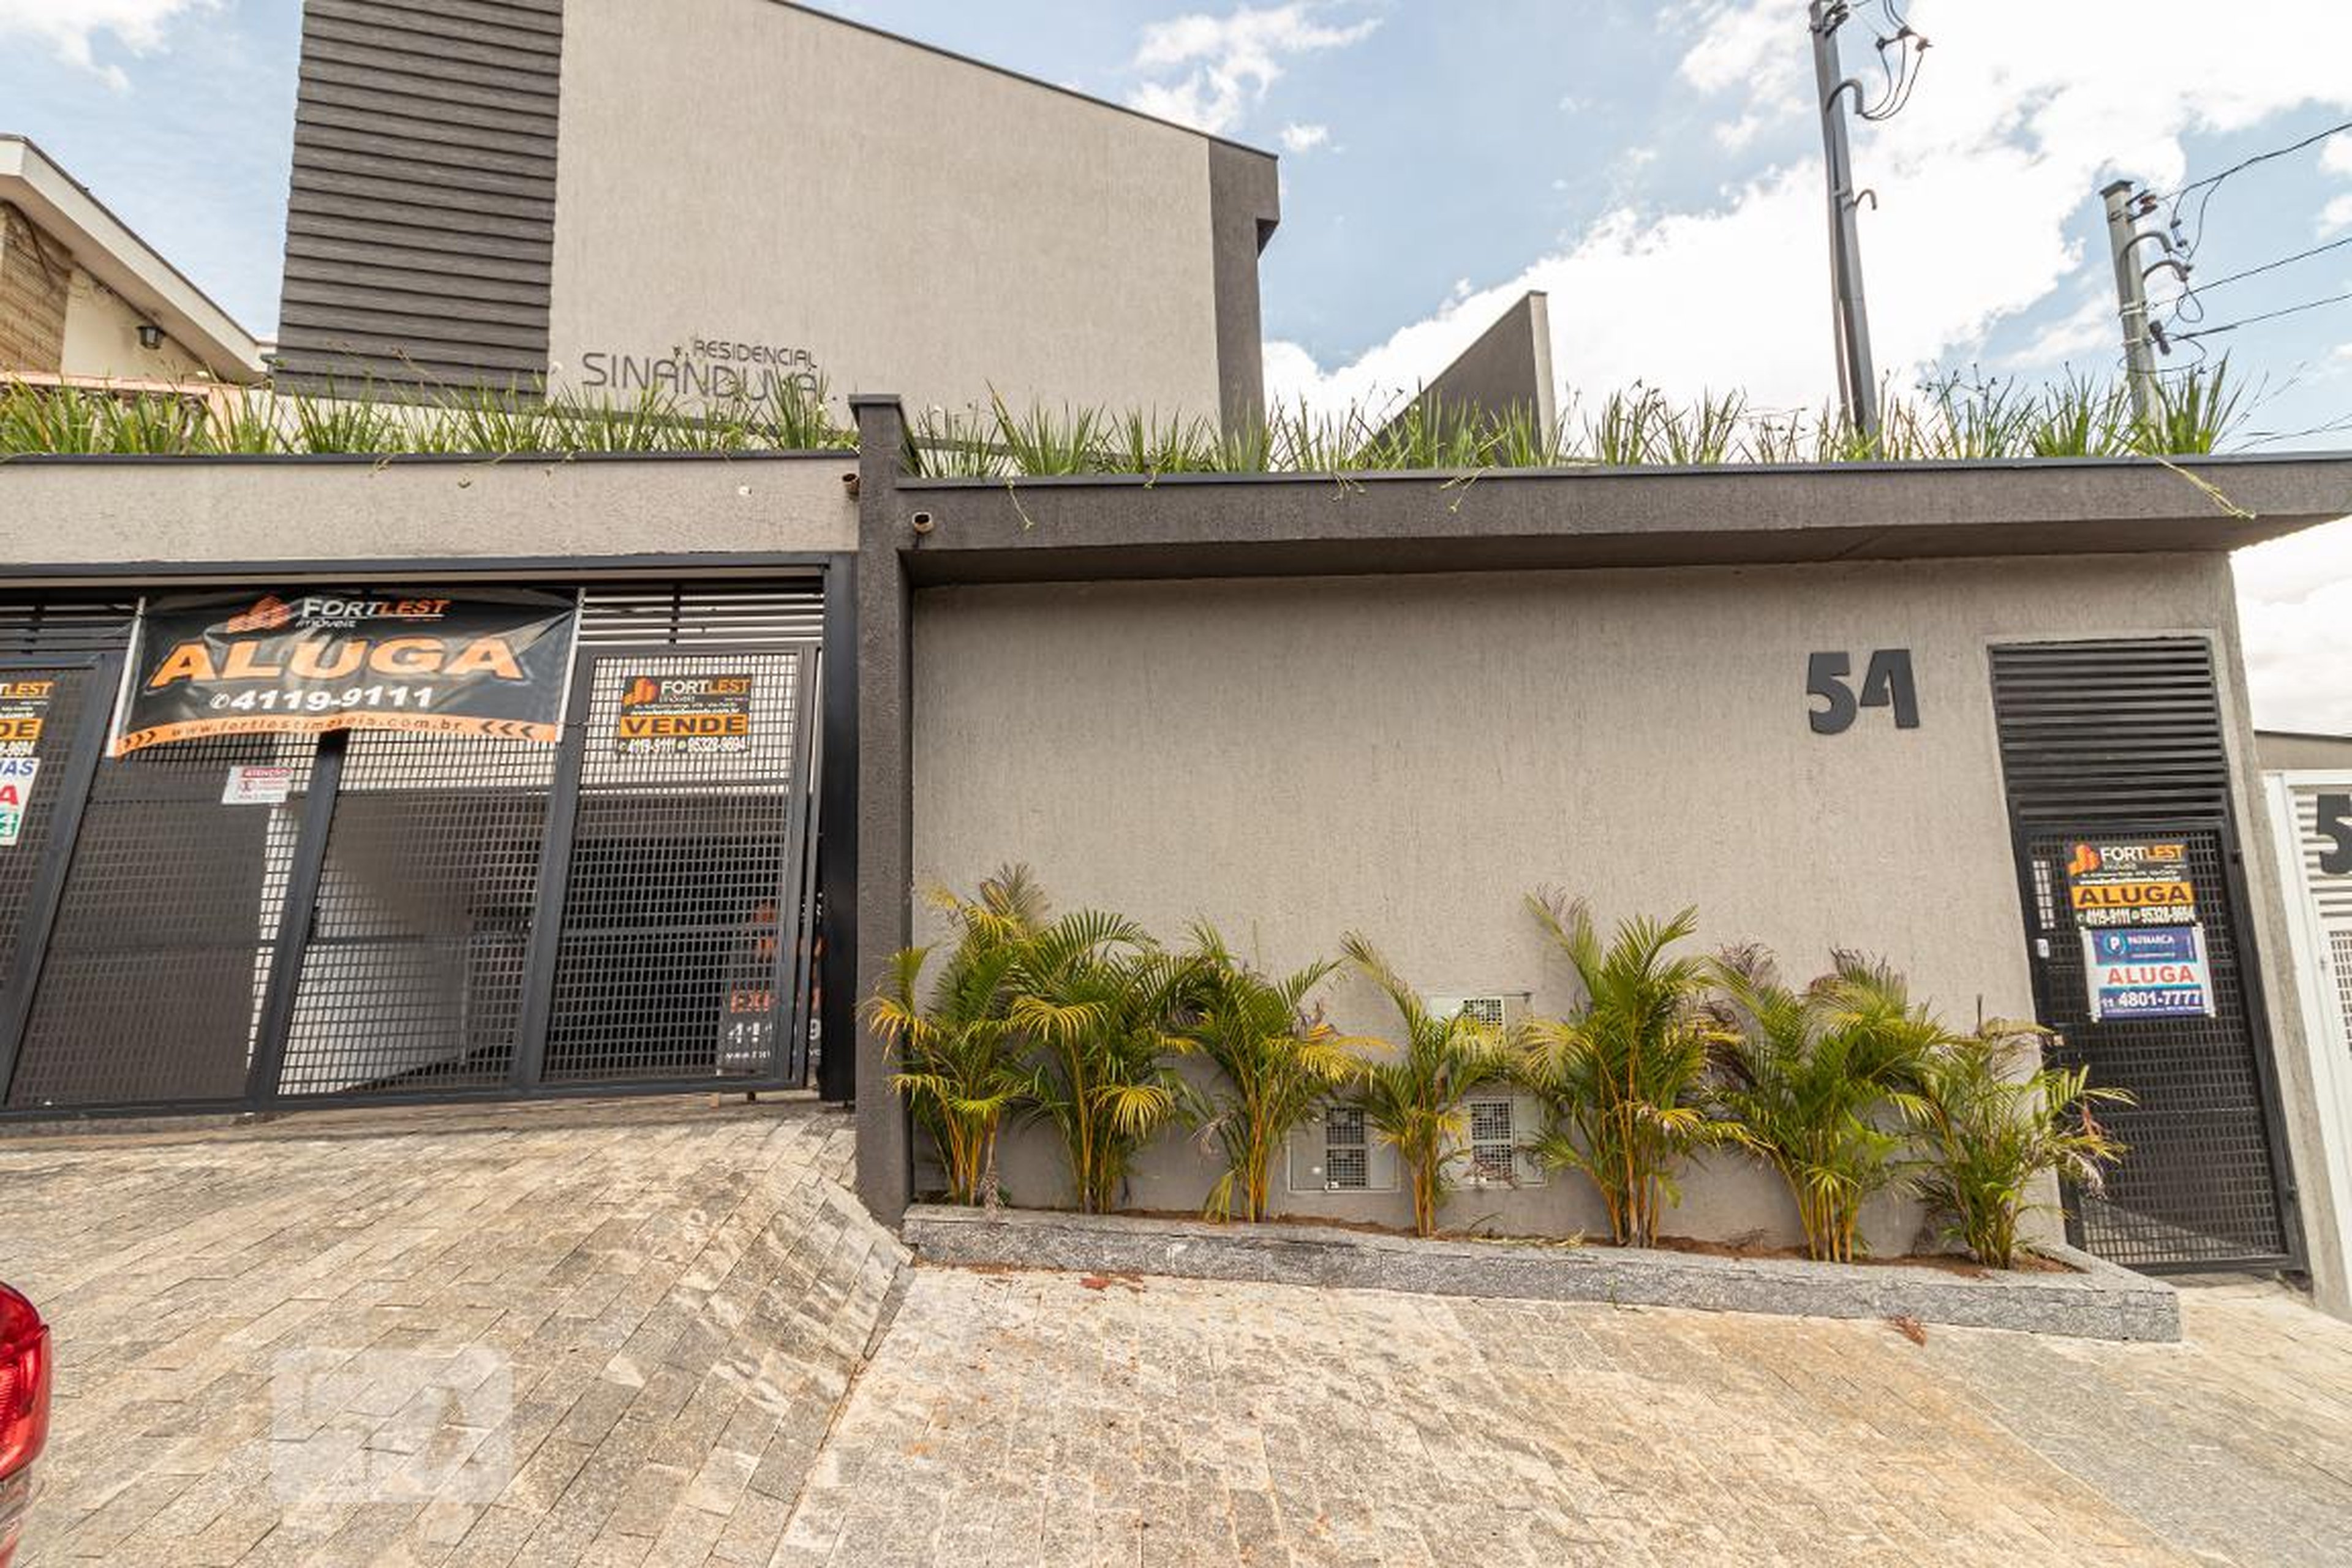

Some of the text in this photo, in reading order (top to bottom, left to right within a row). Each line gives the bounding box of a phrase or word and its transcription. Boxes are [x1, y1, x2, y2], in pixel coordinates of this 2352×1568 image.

[693, 339, 818, 369] RESIDENCIAL
[301, 597, 451, 617] FORTLEST
[147, 633, 524, 690] ALUGA
[660, 679, 751, 695] FORTLEST
[230, 685, 433, 712] 4119-9111
[624, 717, 745, 734] VENDE
[2078, 885, 2188, 905] ALUGA
[2106, 965, 2195, 984] ALUGA
